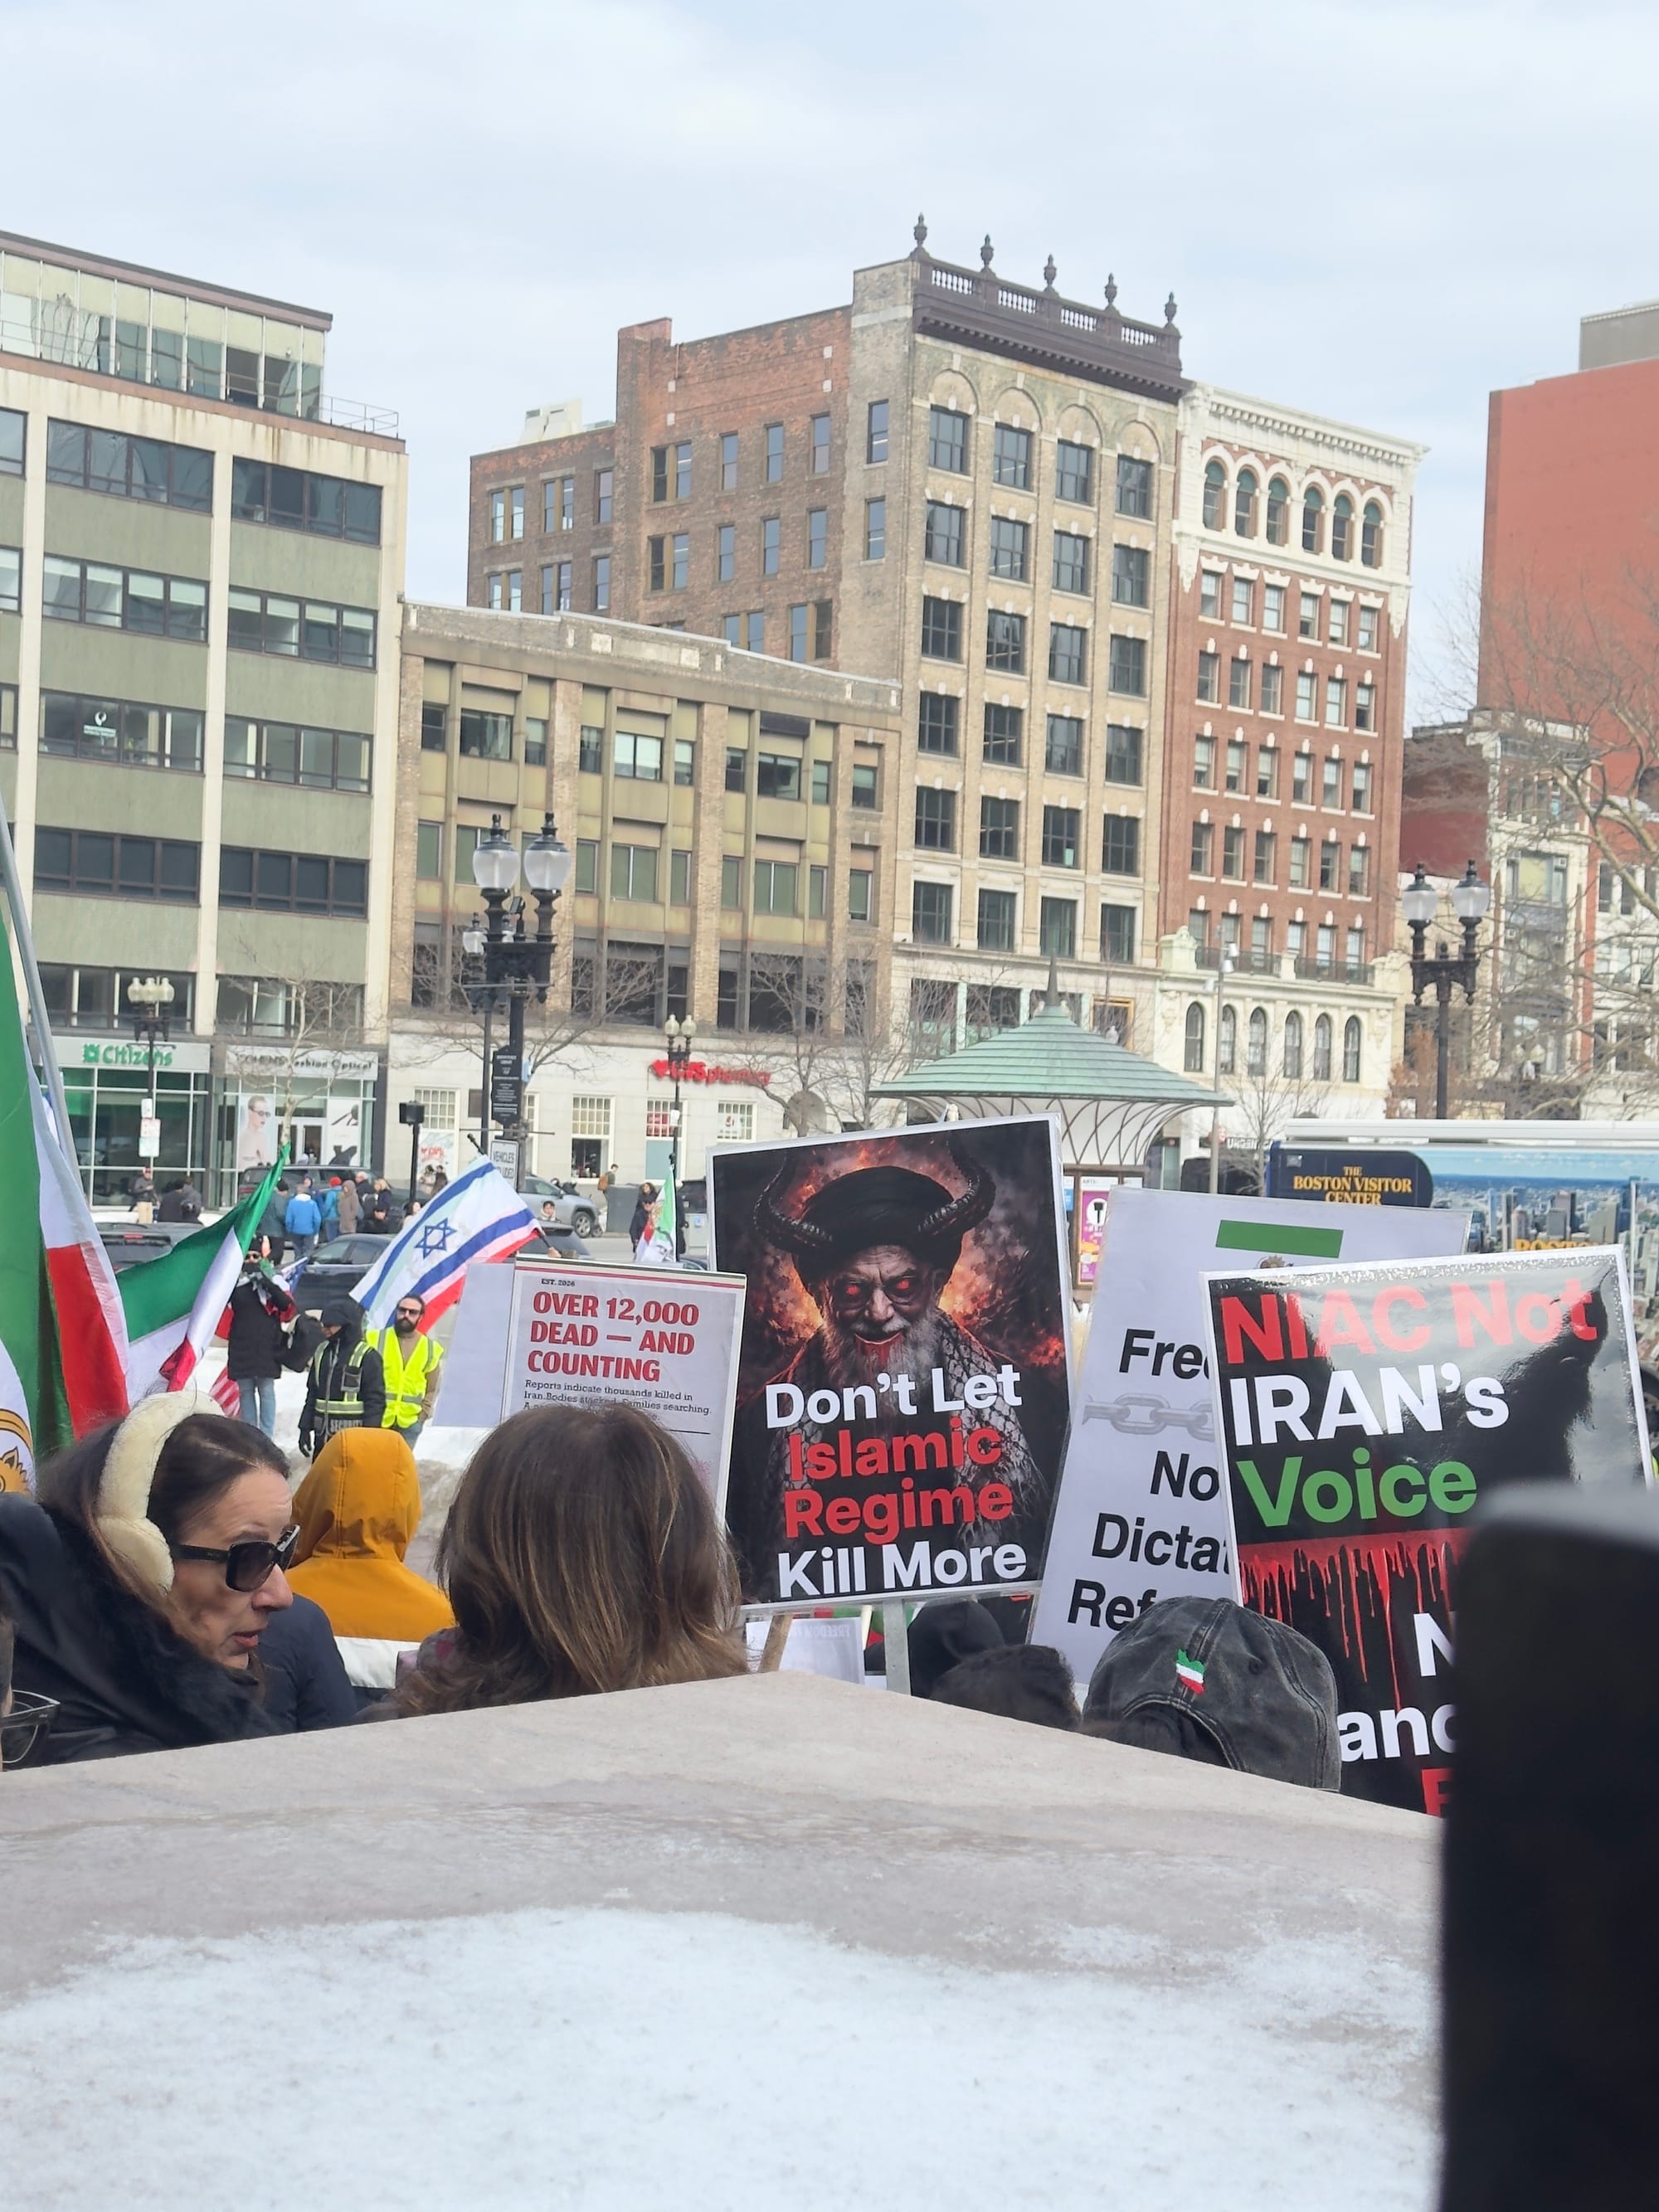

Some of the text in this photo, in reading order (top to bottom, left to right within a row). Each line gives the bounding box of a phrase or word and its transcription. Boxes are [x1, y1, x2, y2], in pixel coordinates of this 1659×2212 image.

[291, 1058, 328, 1067] ashion
[1227, 1137, 1259, 1150] URGEN
[1293, 1175, 1412, 1193] BOSTON VISITOR
[1343, 1166, 1362, 1176] THE
[1325, 1191, 1382, 1205] CENTER
[533, 1291, 699, 1326] OVER 12,000
[1220, 1278, 1598, 1364] NIAC Not
[530, 1320, 598, 1347] DEAD
[639, 1330, 695, 1355] AND
[528, 1349, 660, 1382] COUNTING
[525, 1379, 562, 1390] Reports
[564, 1383, 601, 1393] indicate
[605, 1386, 652, 1397] thousands
[654, 1390, 681, 1401] killed
[765, 1364, 1023, 1429] Don't Let
[1229, 1362, 1510, 1446] IRAN's
[663, 1403, 713, 1416] searching.
[789, 1416, 1002, 1482] Islamic
[1150, 1450, 1220, 1501] No
[1235, 1446, 1477, 1527] Voice
[784, 1476, 1014, 1545] Regime
[778, 1540, 1027, 1598] Kill More
